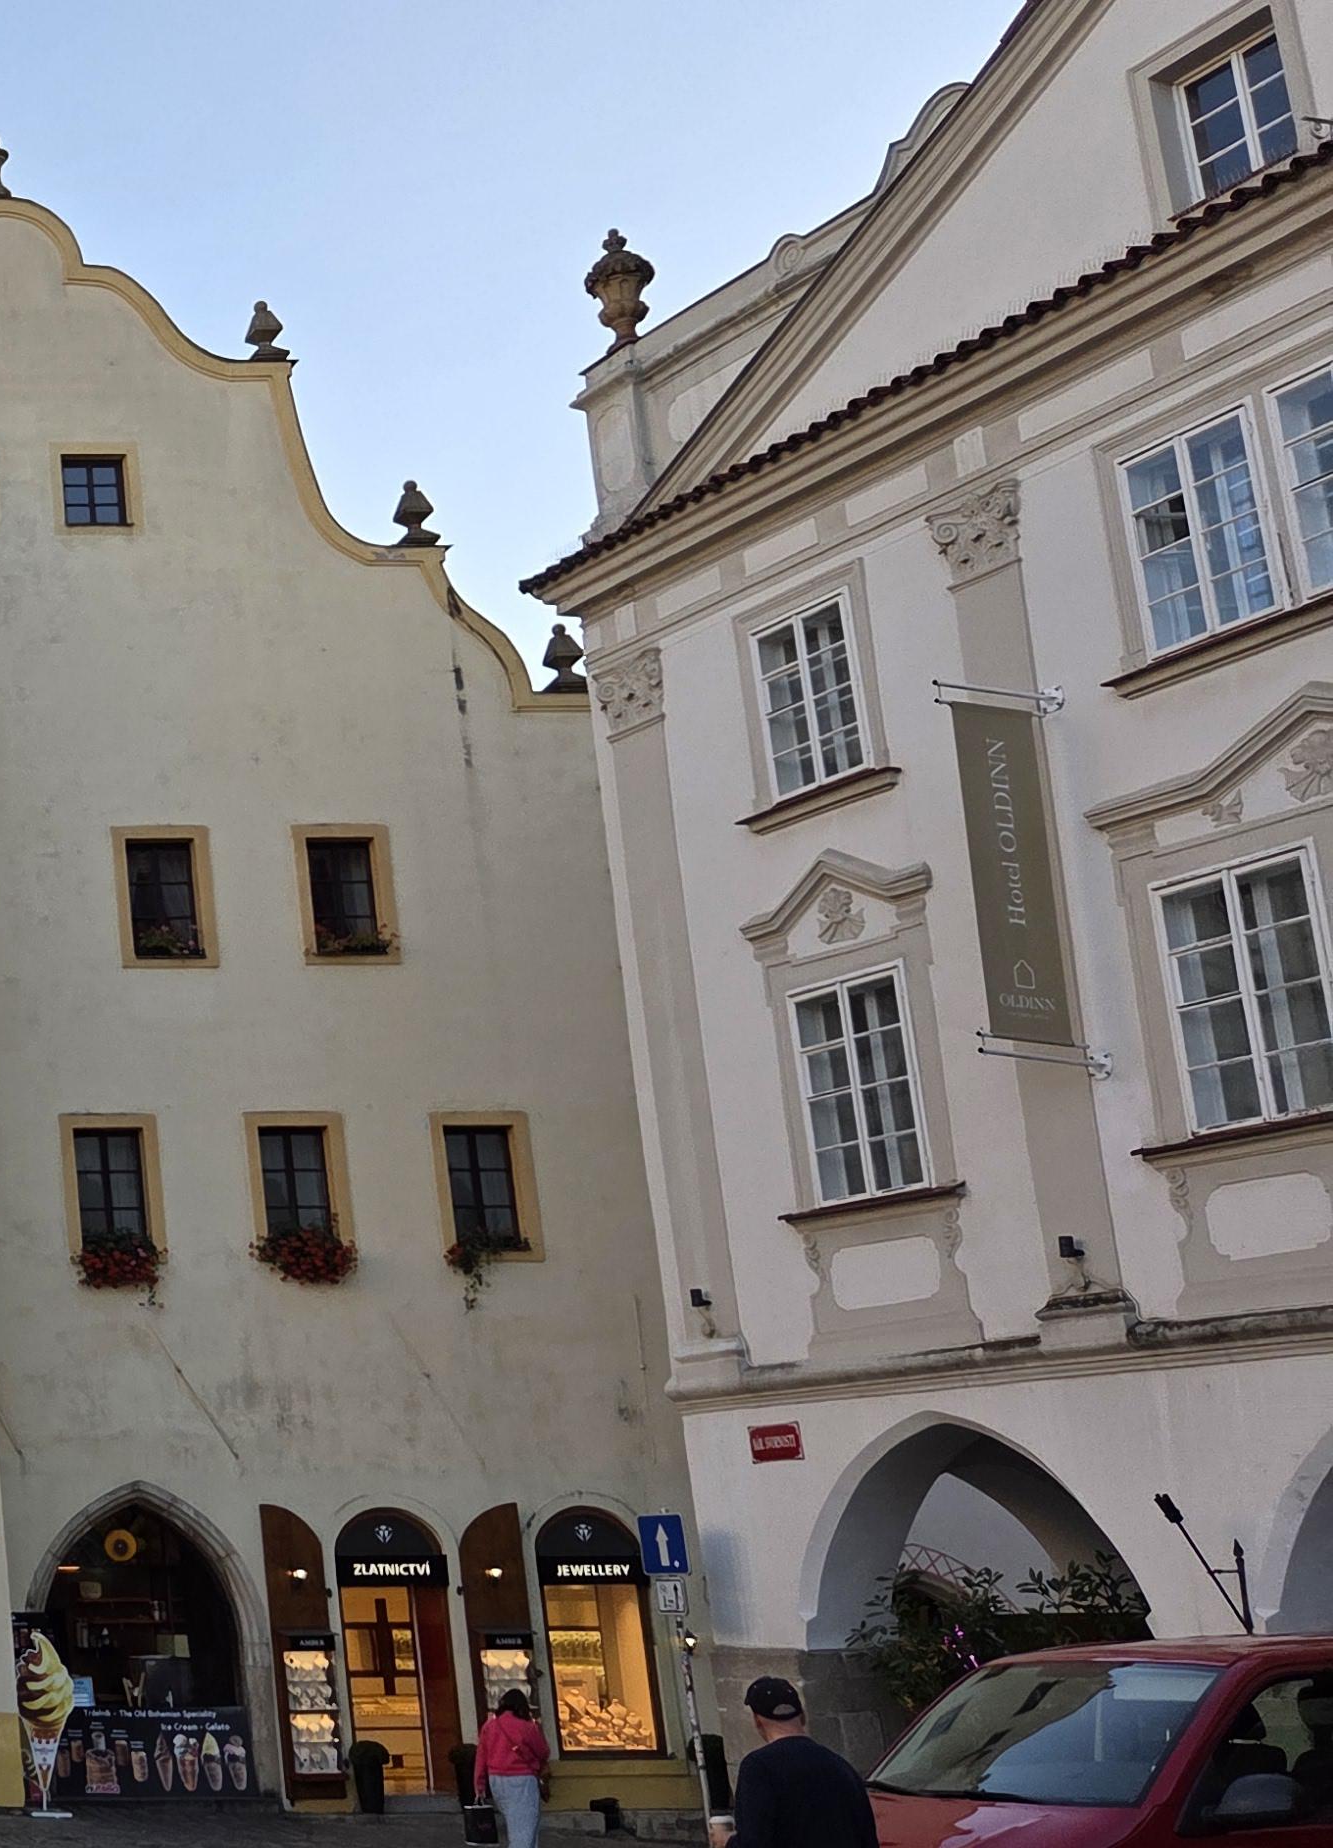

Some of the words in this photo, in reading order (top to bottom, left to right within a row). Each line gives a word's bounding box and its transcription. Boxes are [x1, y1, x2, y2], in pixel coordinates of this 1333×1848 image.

[985, 738, 1018, 853] OLDINN
[1000, 861, 1027, 927] Hotel
[999, 993, 1056, 1010] OLDINN
[353, 1559, 432, 1577] ZLATNICTVÍ
[556, 1564, 631, 1577] JEWELLERY
